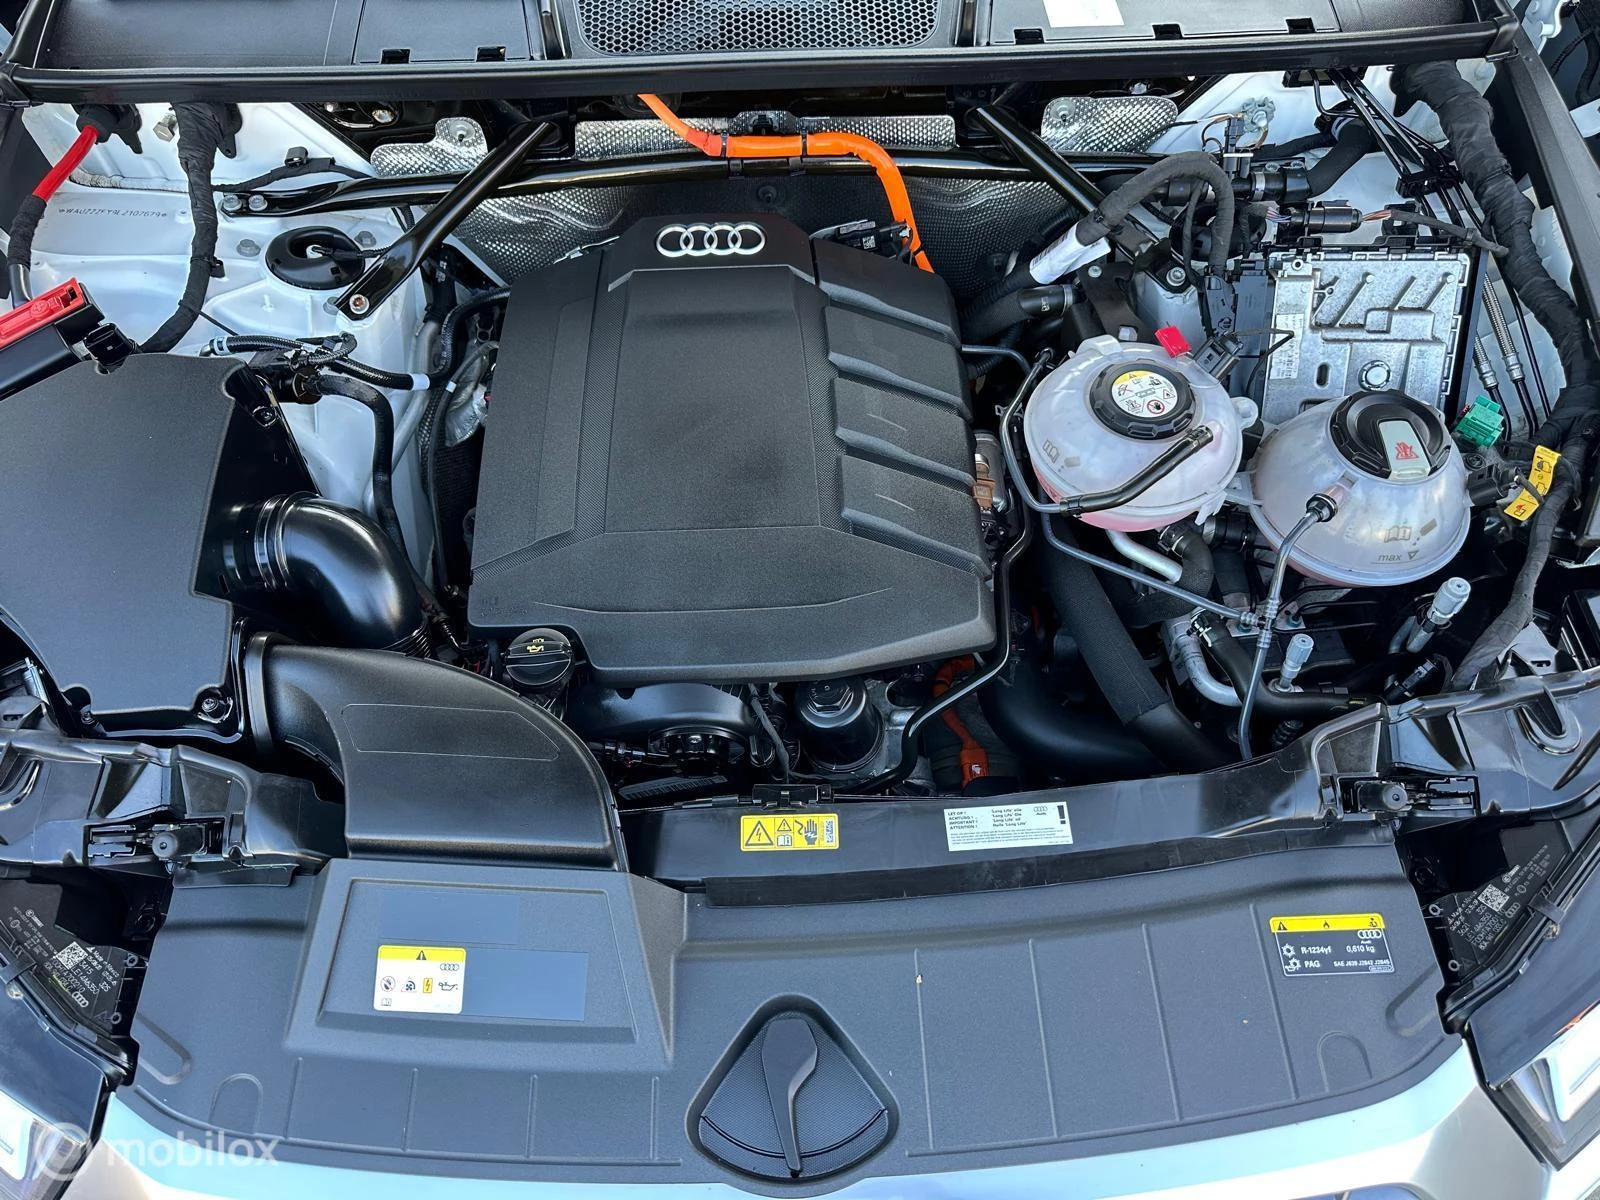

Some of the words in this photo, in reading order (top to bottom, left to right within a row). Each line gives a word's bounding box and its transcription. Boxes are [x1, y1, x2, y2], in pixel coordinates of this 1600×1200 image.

[1378, 553, 1401, 561] max
[1300, 946, 1332, 955] R-1234yf
[1346, 946, 1365, 954] 0,610
[1366, 945, 1376, 954] kg
[1304, 960, 1321, 968] PAG
